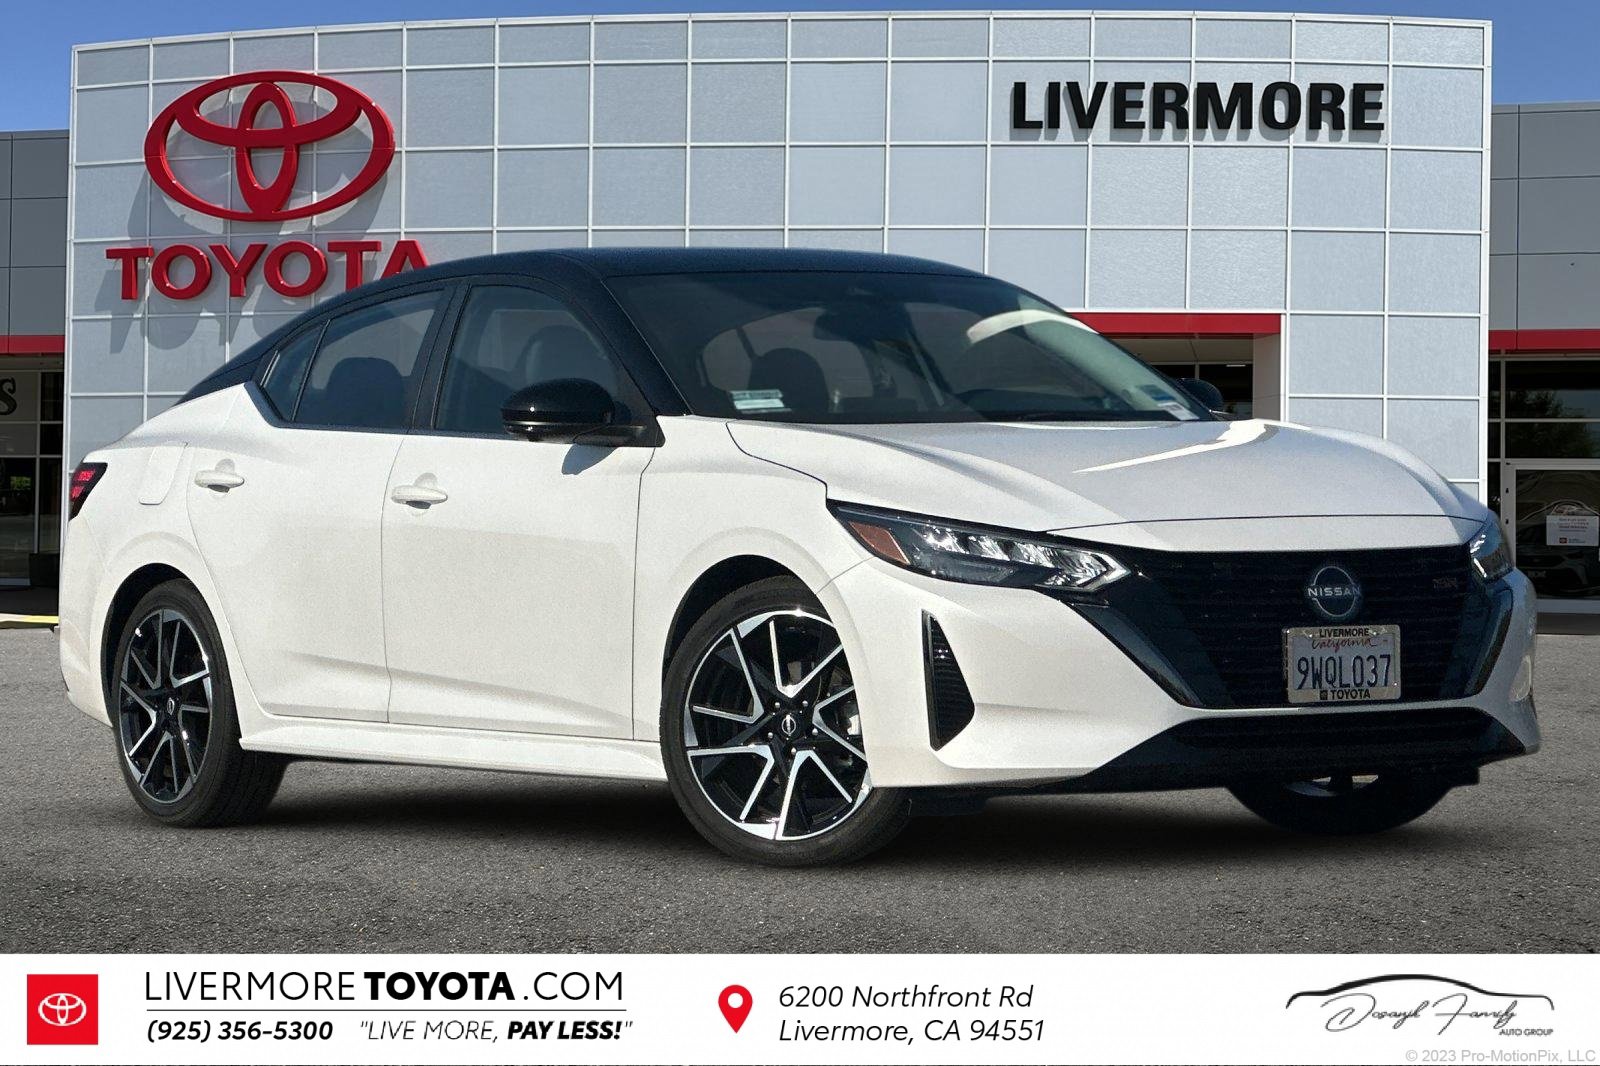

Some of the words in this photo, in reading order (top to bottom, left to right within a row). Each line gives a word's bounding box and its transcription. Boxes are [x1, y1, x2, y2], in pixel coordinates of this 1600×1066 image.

[1012, 81, 1385, 130] LIVERMORE
[106, 240, 429, 299] TOYOTA
[1307, 586, 1361, 598] NISSAN
[1319, 628, 1370, 638] LIVERMORE
[1297, 654, 1391, 690] 9WQL037
[1331, 689, 1371, 700] TOYOTA
